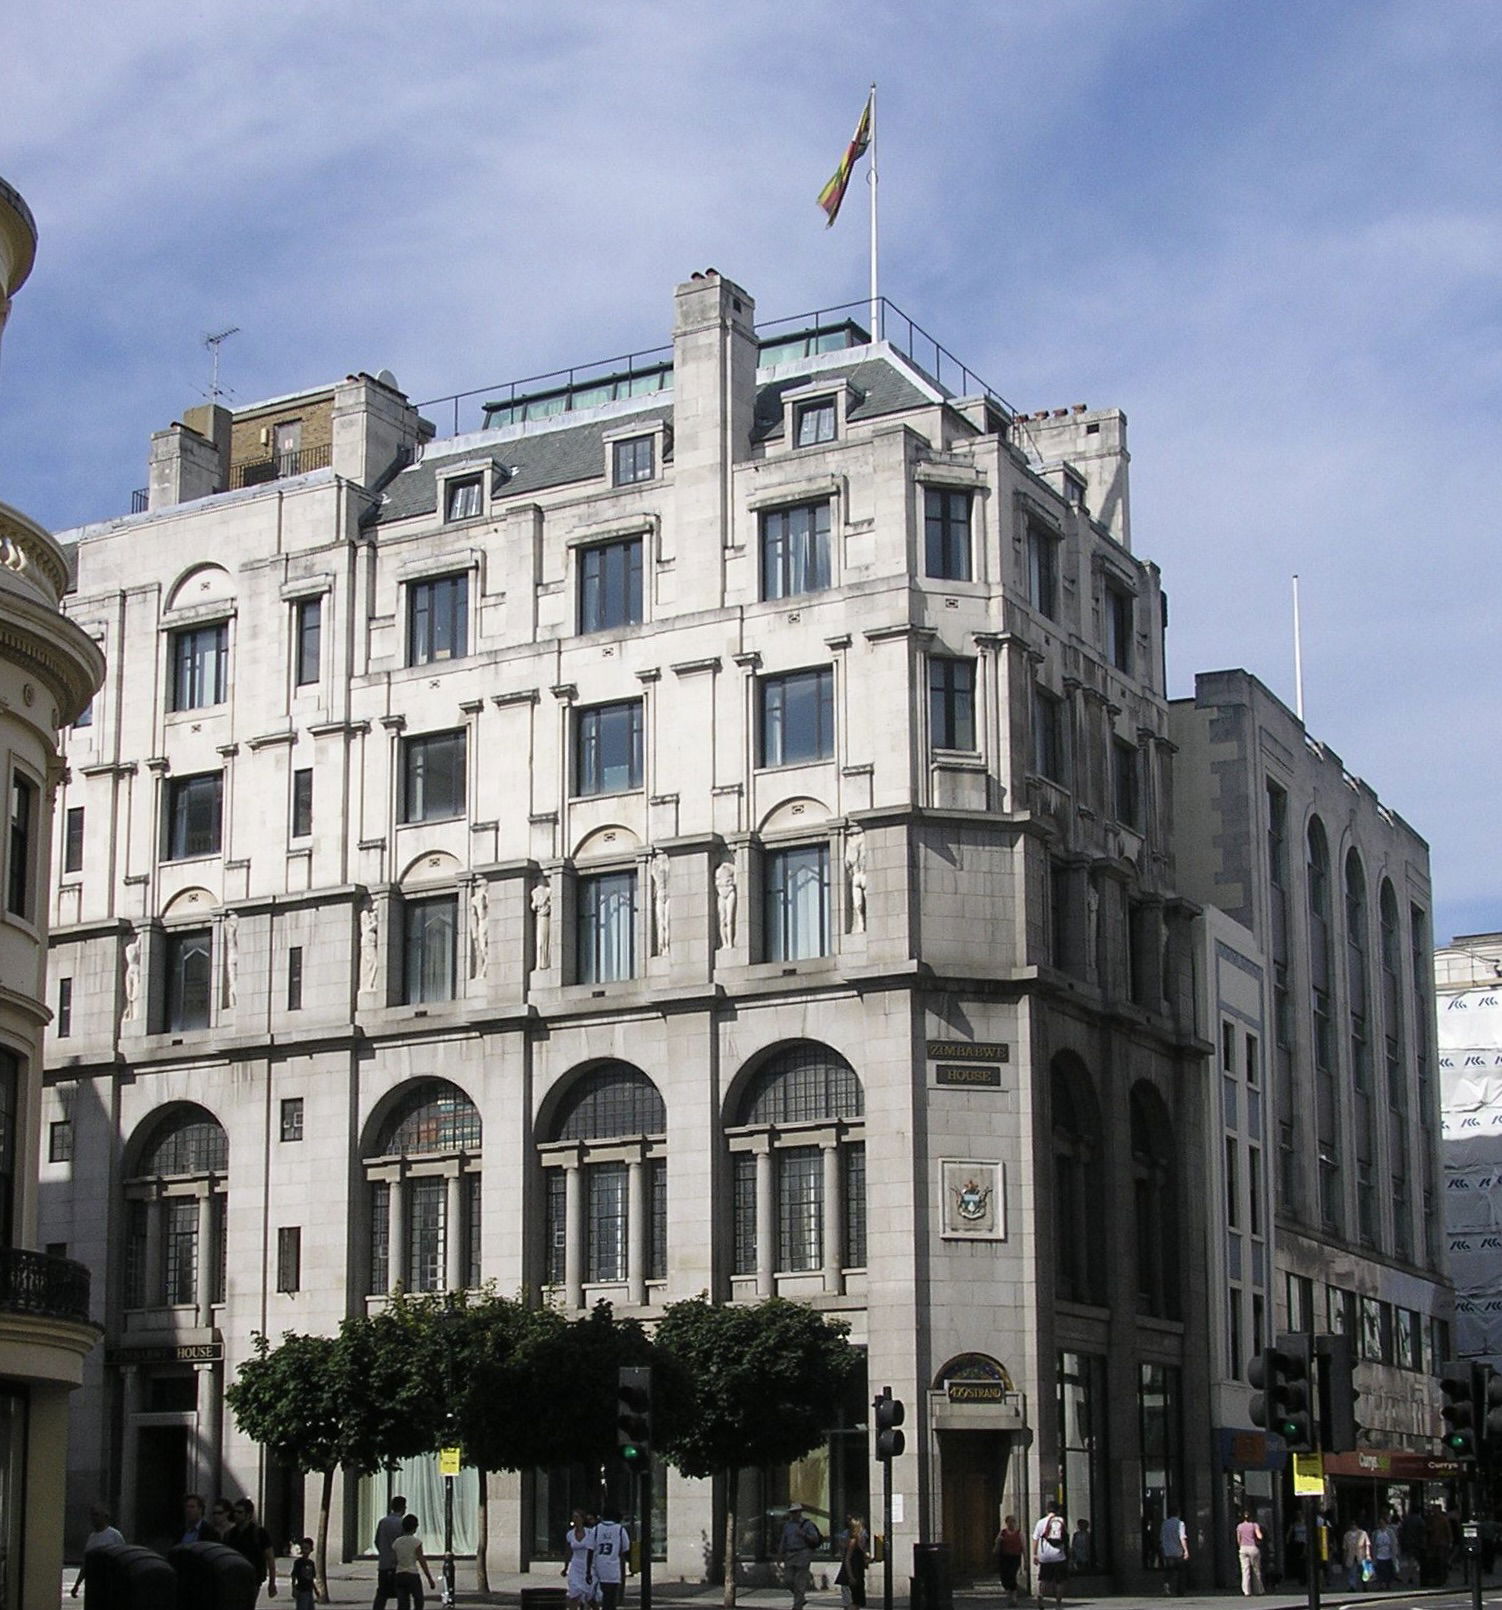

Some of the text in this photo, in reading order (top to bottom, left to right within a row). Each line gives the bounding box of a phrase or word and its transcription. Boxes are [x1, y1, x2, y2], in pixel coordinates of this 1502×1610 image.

[930, 1045, 1007, 1057] ZIMBABWE
[947, 1070, 991, 1080] HOUSE
[177, 1346, 213, 1358] HOUSE
[968, 1387, 1001, 1397] STRAND
[1428, 1461, 1459, 1470] Currys
